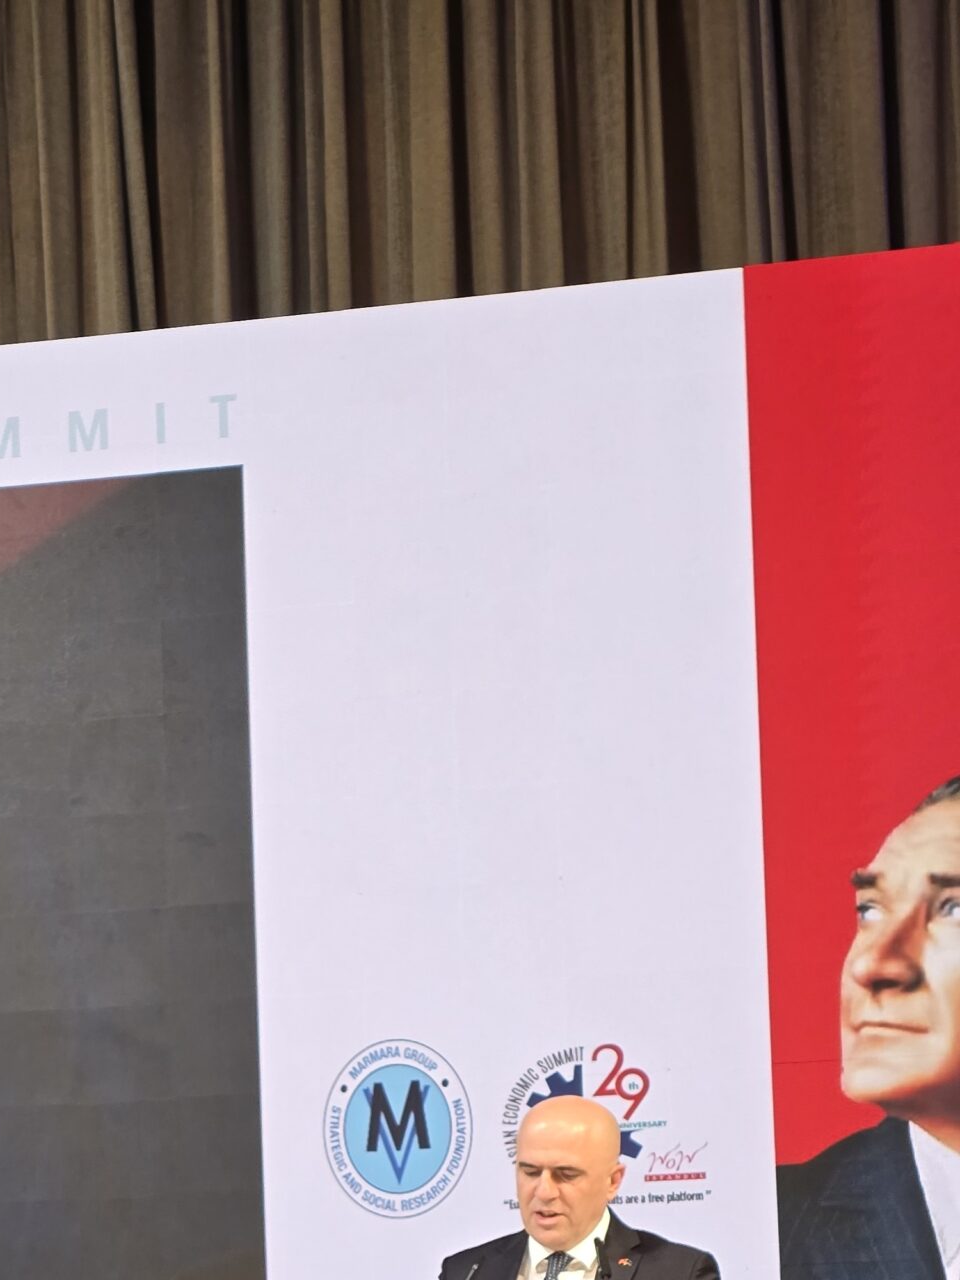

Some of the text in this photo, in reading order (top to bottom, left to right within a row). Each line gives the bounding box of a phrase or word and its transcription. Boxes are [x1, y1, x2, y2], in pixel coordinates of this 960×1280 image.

[348, 1046, 438, 1079] MARMARA GROUP
[502, 1068, 540, 1125] ECONOMIC
[537, 1046, 584, 1074] SUMMIT
[591, 1043, 650, 1121] 29
[329, 1098, 467, 1212] STRATEGIC AND SOCIAL RESEARCH FOUNDATION
[666, 1191, 704, 1204] platform
